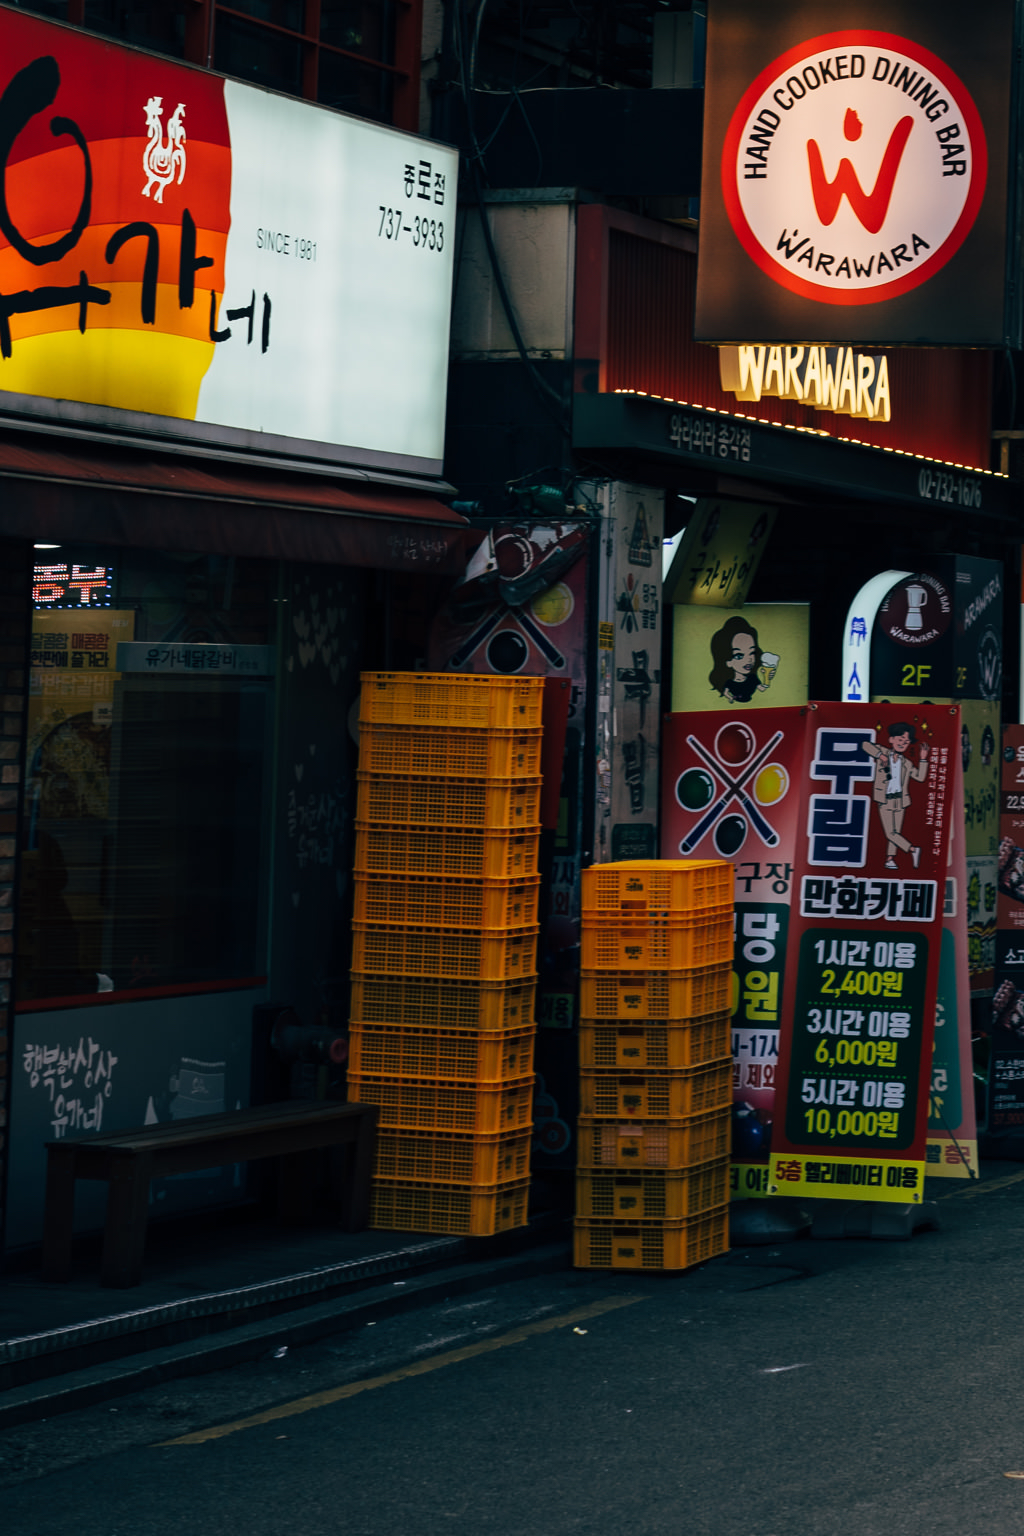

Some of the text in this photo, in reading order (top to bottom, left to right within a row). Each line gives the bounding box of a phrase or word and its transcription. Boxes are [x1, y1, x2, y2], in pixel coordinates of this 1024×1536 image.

[743, 54, 967, 180] HAND COOKED DINING BAR
[403, 160, 447, 206] 종로점
[256, 227, 318, 261] SINCE 1981
[377, 206, 445, 253] 737-3933
[776, 228, 931, 279] WARAWARA
[737, 345, 892, 423] WARAWARA
[918, 466, 983, 510] 02-732-1676
[889, 625, 940, 644] WARAWARA
[145, 648, 238, 669] 유가네닭갈비
[901, 664, 932, 687] 2F
[809, 729, 877, 866] 무림
[801, 876, 938, 923] 만화카페
[813, 938, 917, 969] 1시간 이용
[819, 969, 903, 998] 2,400원
[806, 1009, 912, 1039] 3시간 이용
[22, 1037, 118, 1101] 행복한 상상
[814, 1039, 899, 1069] 6,000원
[800, 1077, 906, 1110] 5시간 이용
[50, 1093, 105, 1140] 유가네
[802, 1109, 900, 1140] 10,000원
[774, 1159, 919, 1190] 5층 엘리베이터 이용
